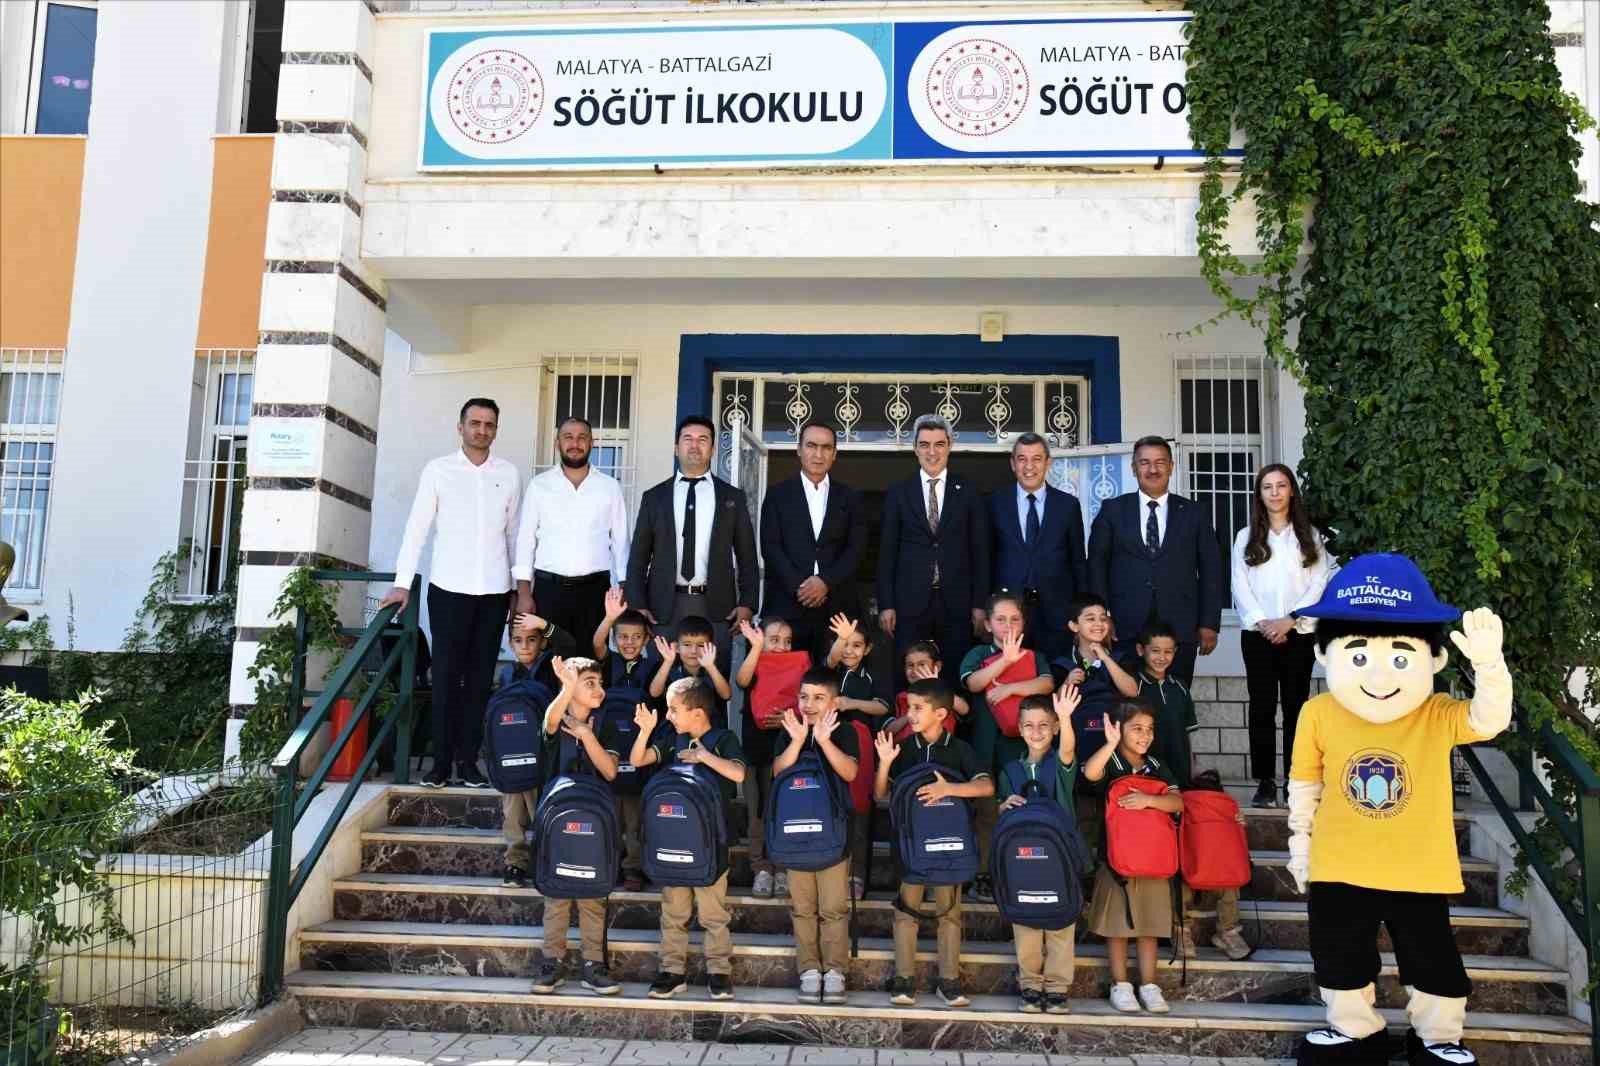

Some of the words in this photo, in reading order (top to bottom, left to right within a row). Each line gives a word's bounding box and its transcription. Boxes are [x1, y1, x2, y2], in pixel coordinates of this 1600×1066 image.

[556, 58, 643, 75] MALATYA
[659, 53, 773, 74] BATTALGAZİ
[1040, 46, 1131, 63] MALATYA
[553, 87, 676, 127] SÖĞÜT
[685, 86, 863, 124] İLKOKULU
[1039, 76, 1154, 116] SÖĞÜT
